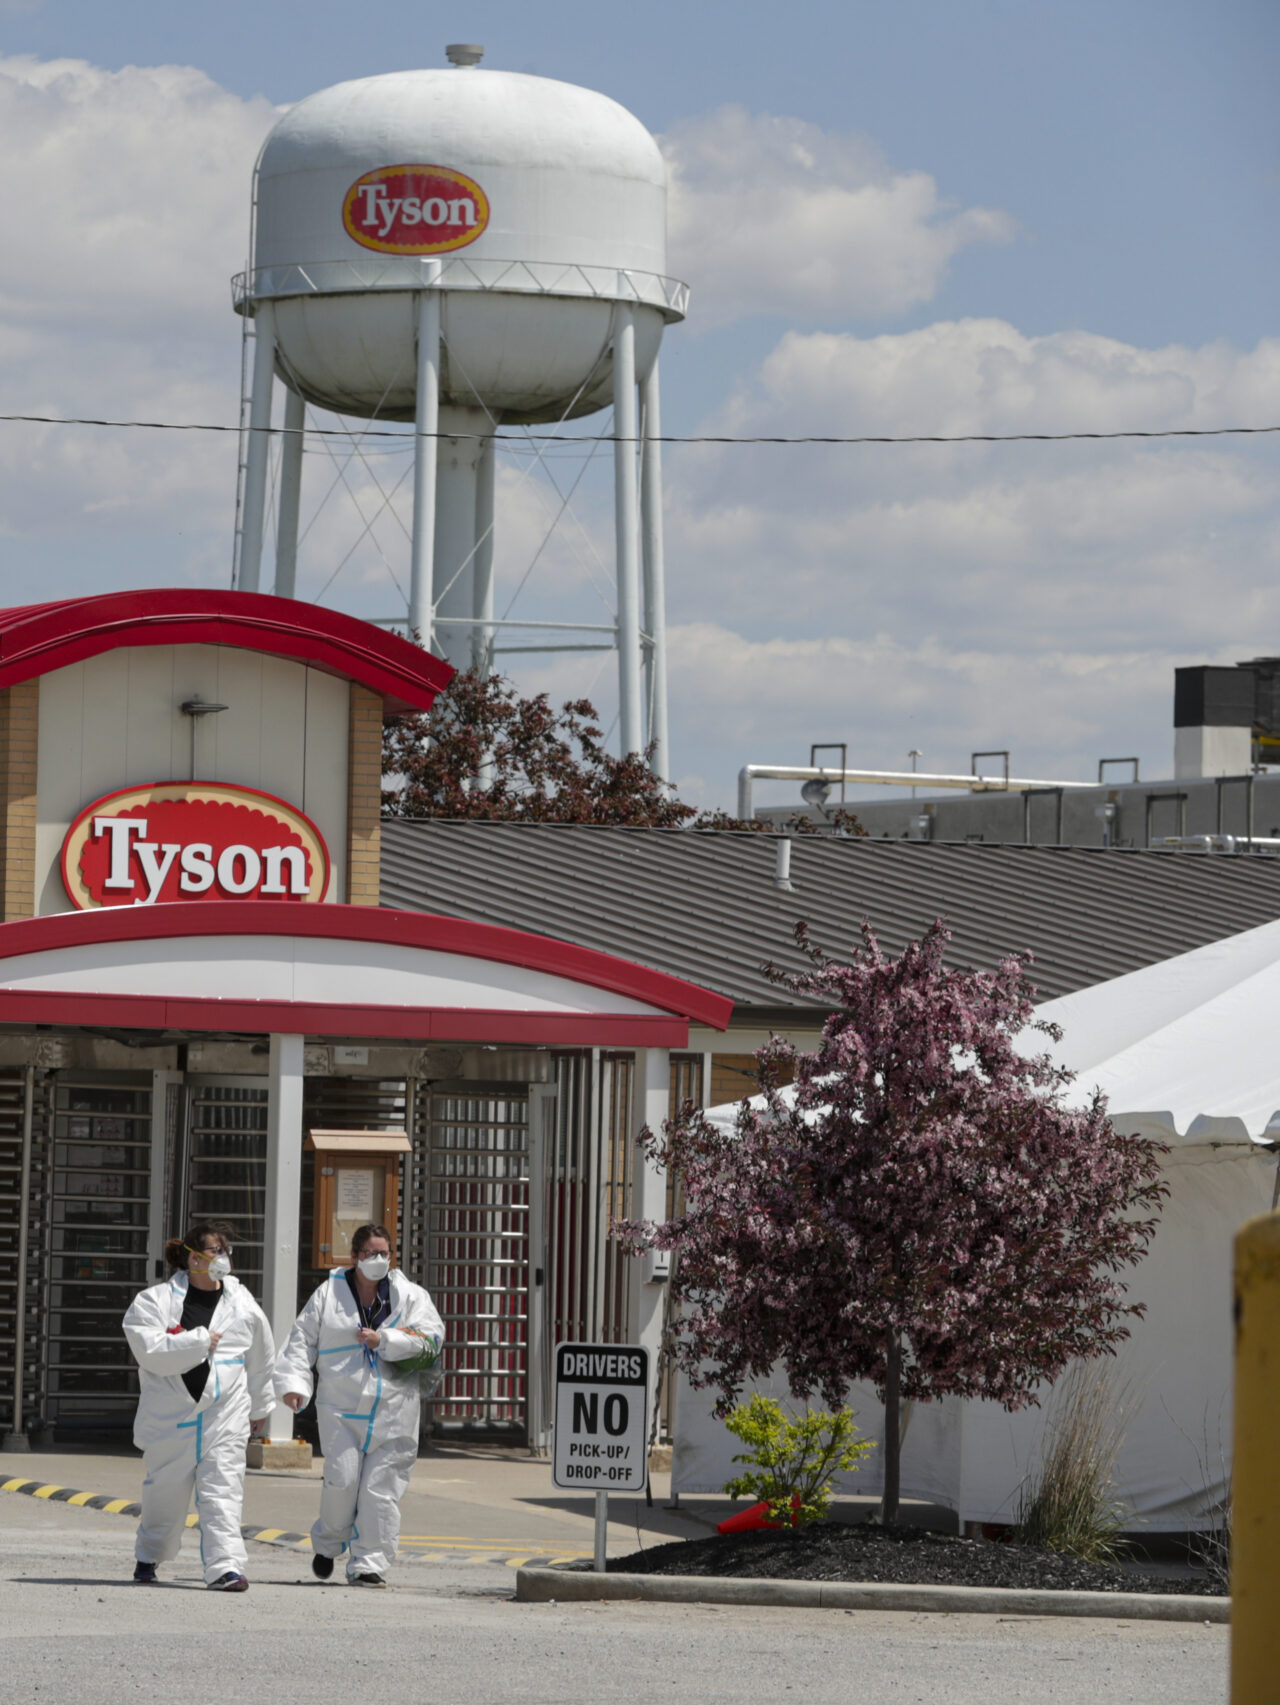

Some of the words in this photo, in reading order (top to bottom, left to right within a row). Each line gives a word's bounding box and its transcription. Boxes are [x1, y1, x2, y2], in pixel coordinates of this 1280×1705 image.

[357, 184, 478, 237] Tyson
[93, 816, 311, 905] Tyson
[562, 1352, 642, 1379] DRIVERS
[572, 1391, 629, 1437] NO
[569, 1443, 631, 1459] PICK-UP/
[566, 1464, 633, 1481] DROP-OFF
